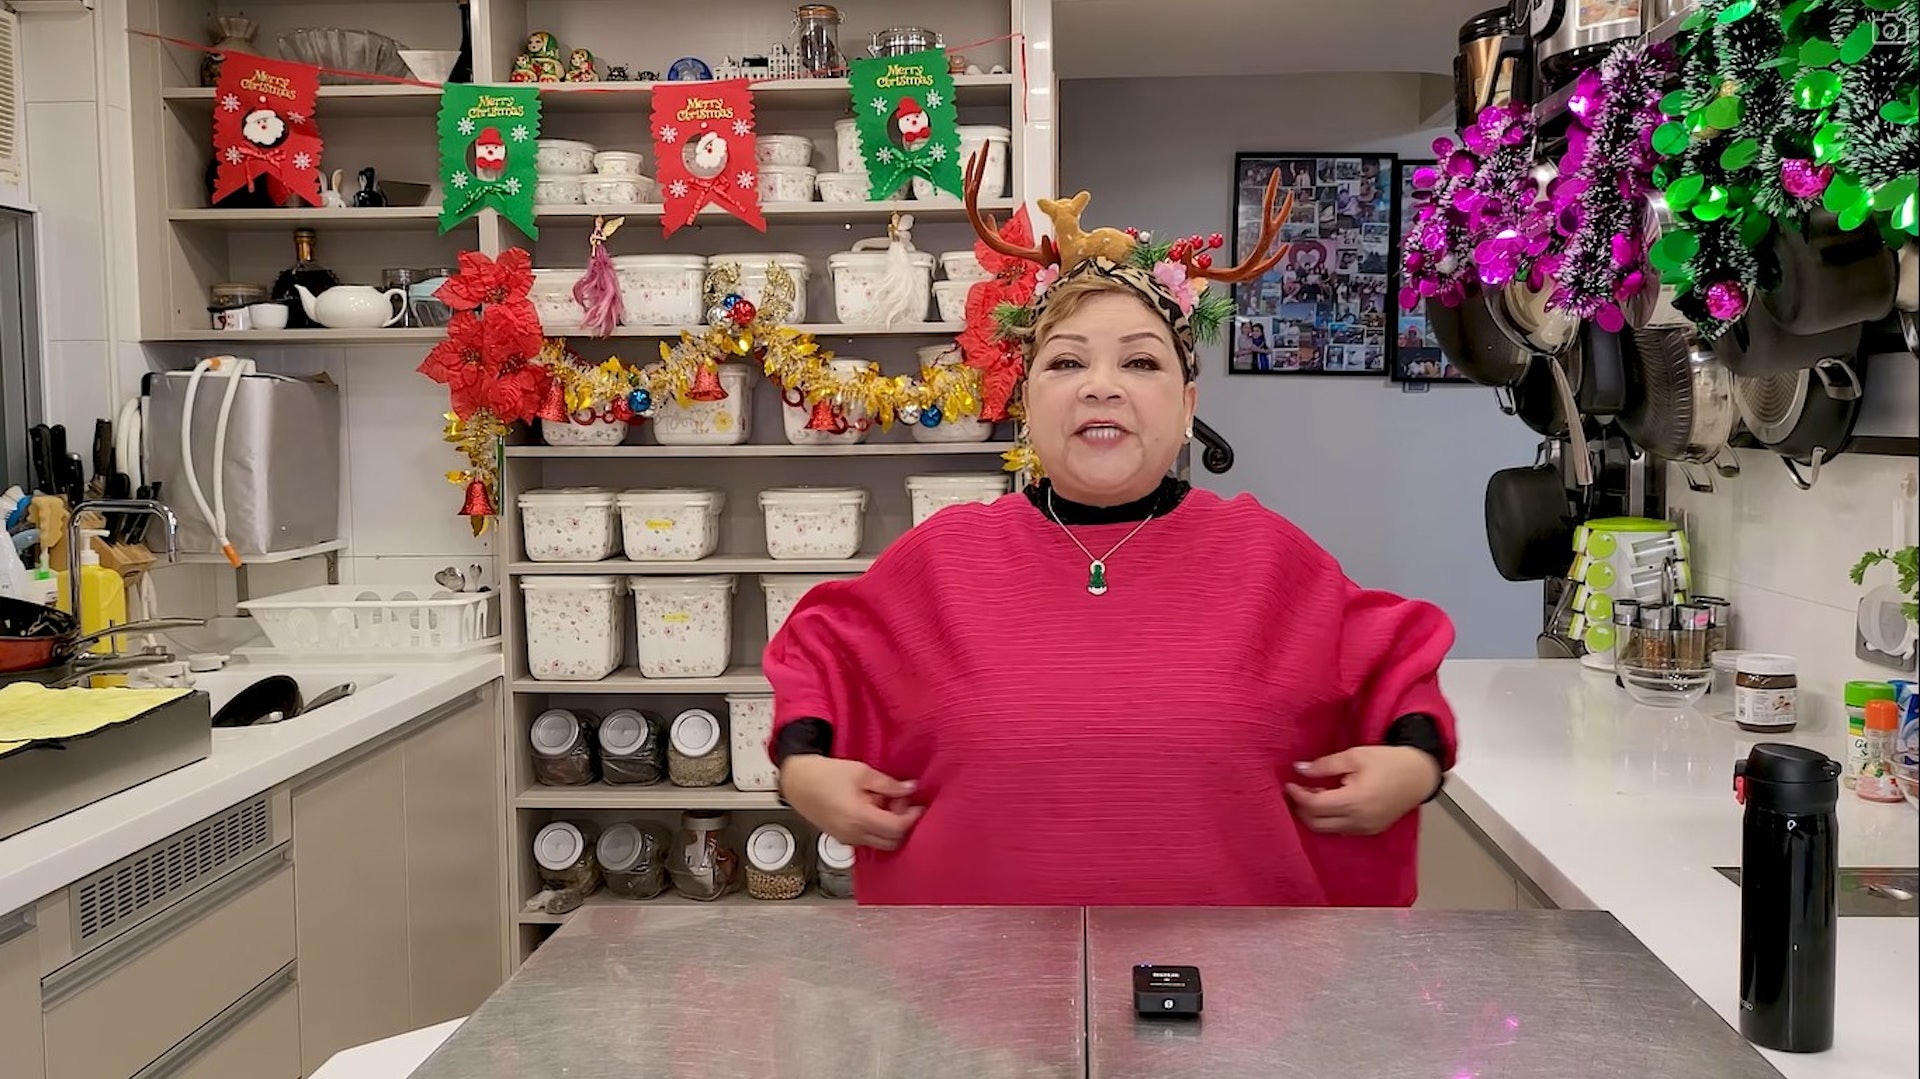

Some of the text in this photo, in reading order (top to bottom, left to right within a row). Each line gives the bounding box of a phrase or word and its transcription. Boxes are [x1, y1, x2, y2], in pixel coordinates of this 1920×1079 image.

[886, 64, 924, 77] Merry
[250, 69, 291, 89] Merry
[876, 74, 934, 88] Christmas
[240, 79, 297, 100] Christmas
[477, 95, 515, 109] Merry
[686, 97, 724, 110] Merry
[468, 105, 525, 119] Christmas
[676, 107, 734, 121] Christmas
